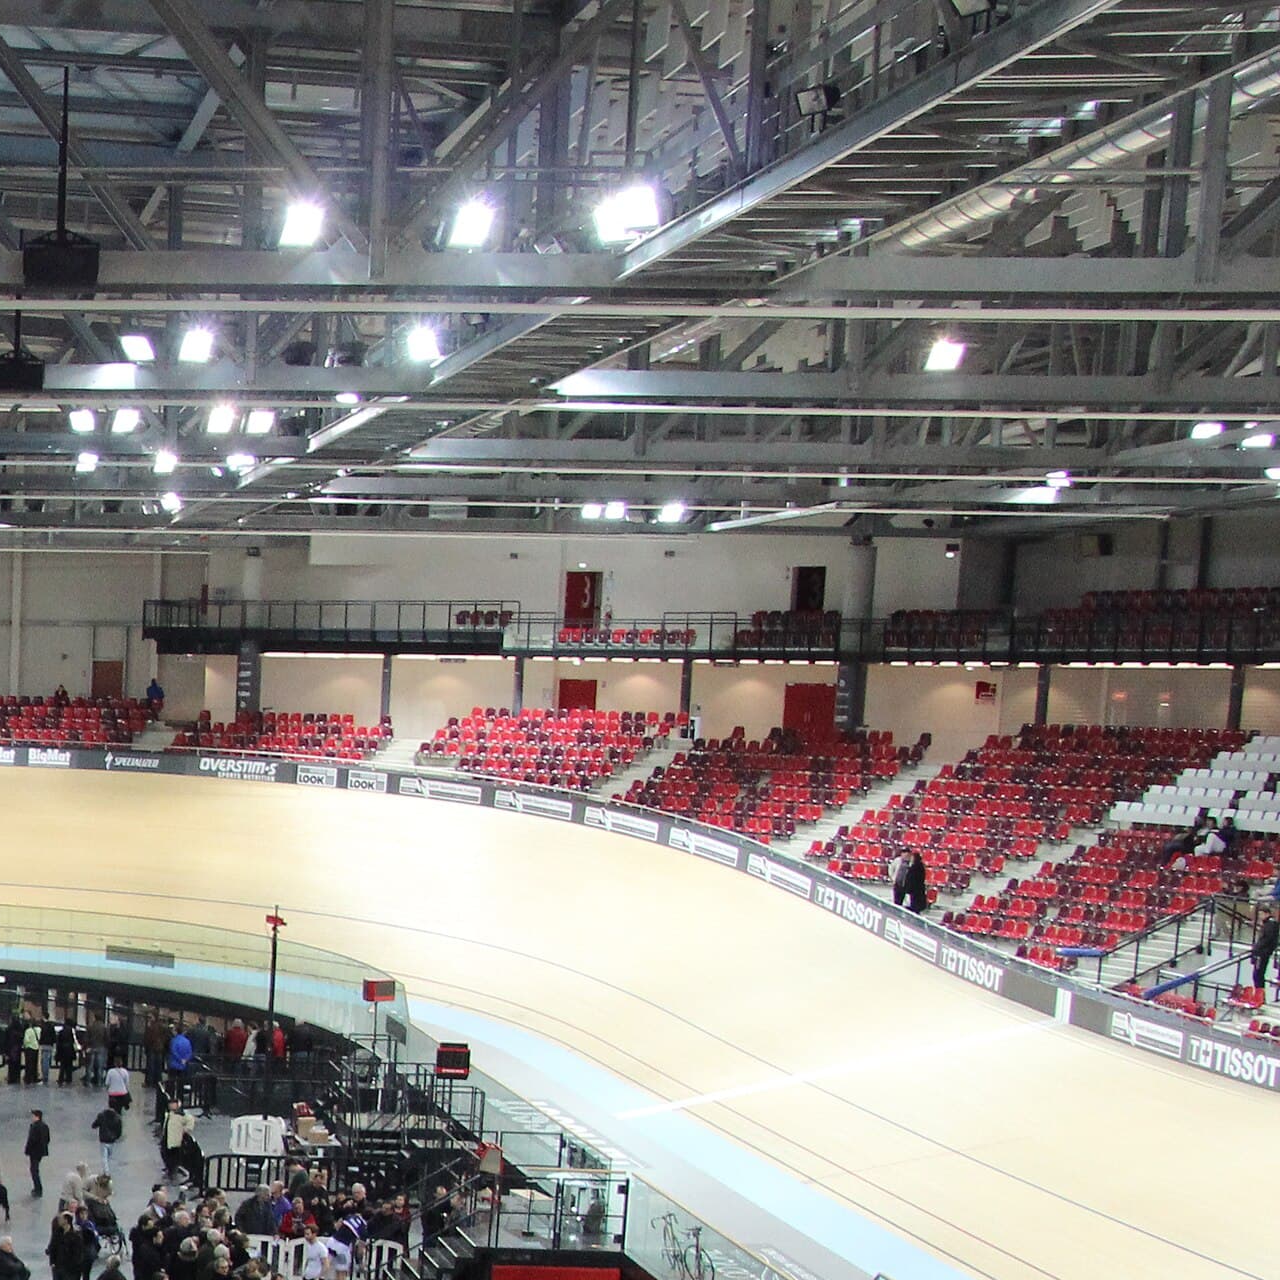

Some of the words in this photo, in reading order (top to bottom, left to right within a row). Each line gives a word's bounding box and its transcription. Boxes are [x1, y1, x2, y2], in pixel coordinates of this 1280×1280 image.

[113, 757, 160, 768] SPECIALIZED
[298, 773, 325, 785] LOOK
[349, 779, 376, 790] LOOK
[834, 891, 883, 933] TISSOT
[957, 951, 1004, 992] TISSOT
[1213, 1041, 1280, 1087] TISSOT
